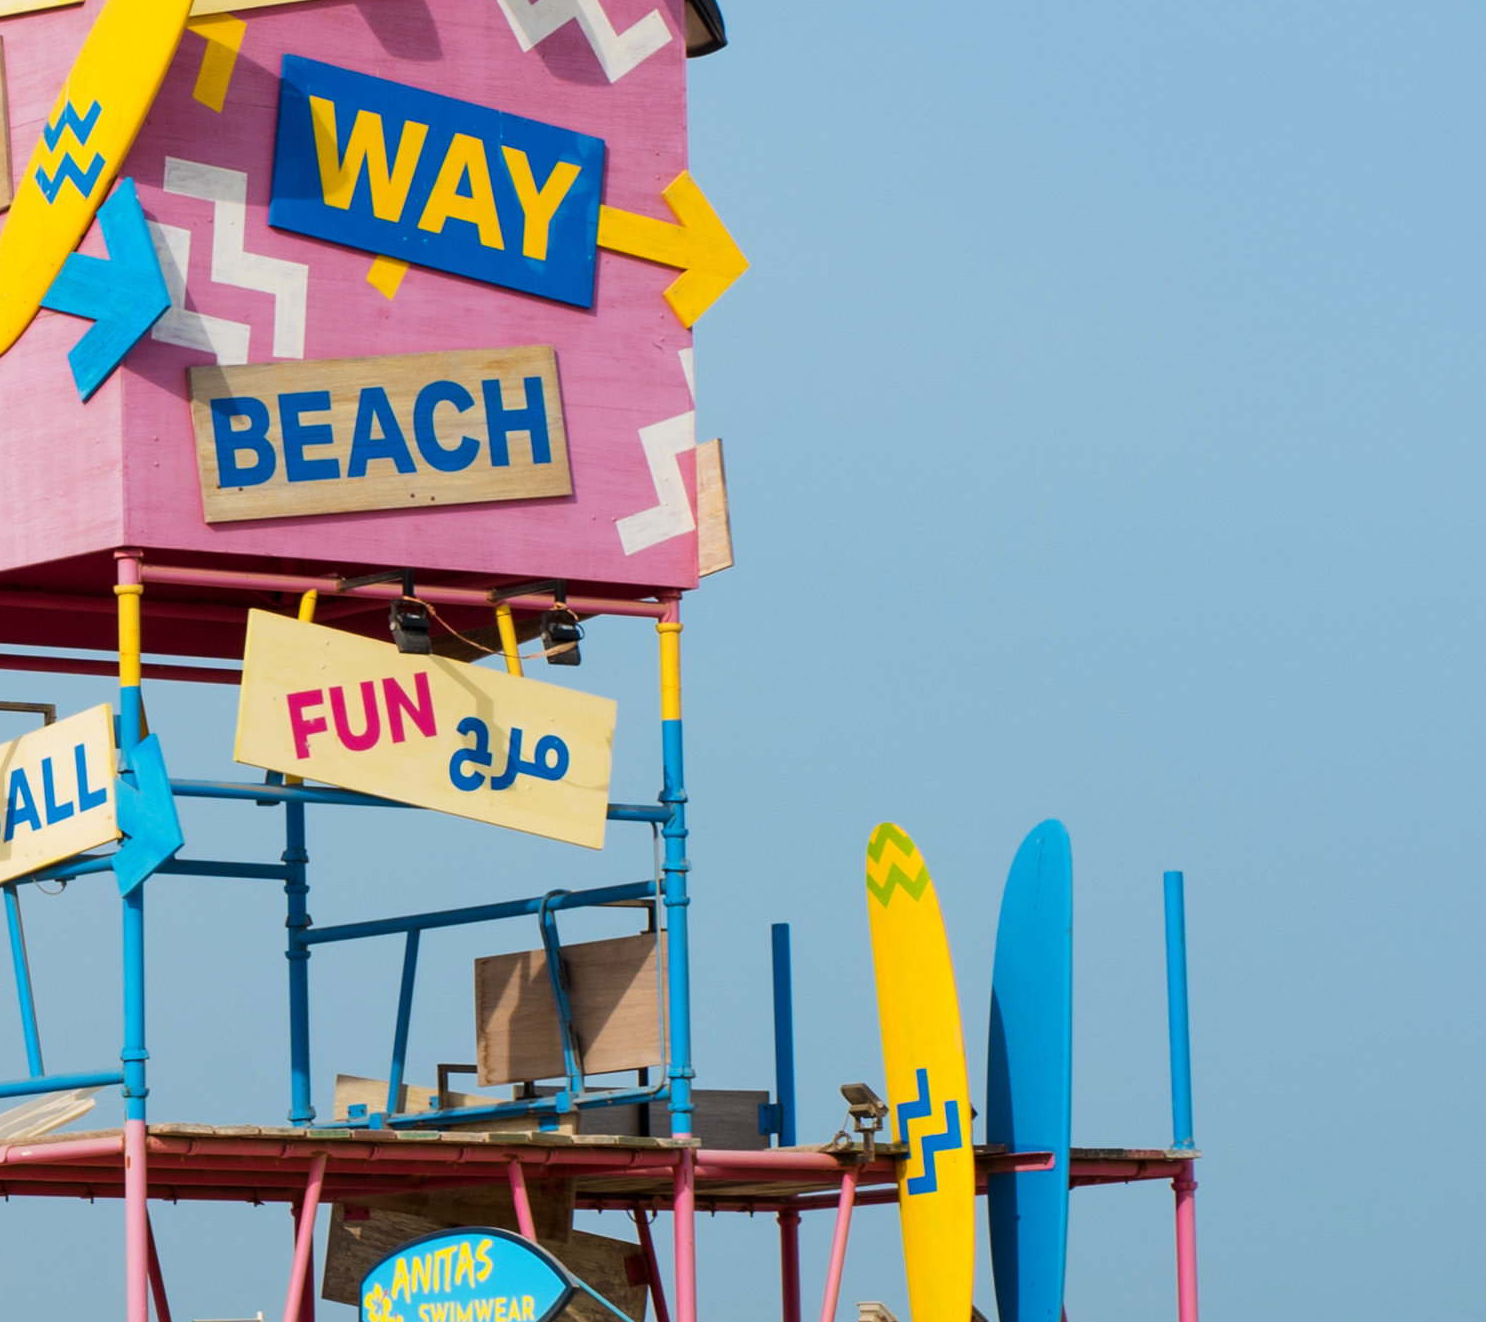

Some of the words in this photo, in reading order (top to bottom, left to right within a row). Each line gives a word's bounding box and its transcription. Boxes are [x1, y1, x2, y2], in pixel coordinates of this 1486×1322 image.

[308, 94, 581, 261] WAY
[210, 376, 552, 488] BEACH
[286, 672, 438, 760] FUN
[448, 716, 570, 792] مرح
[391, 1238, 493, 1304] ANITAS
